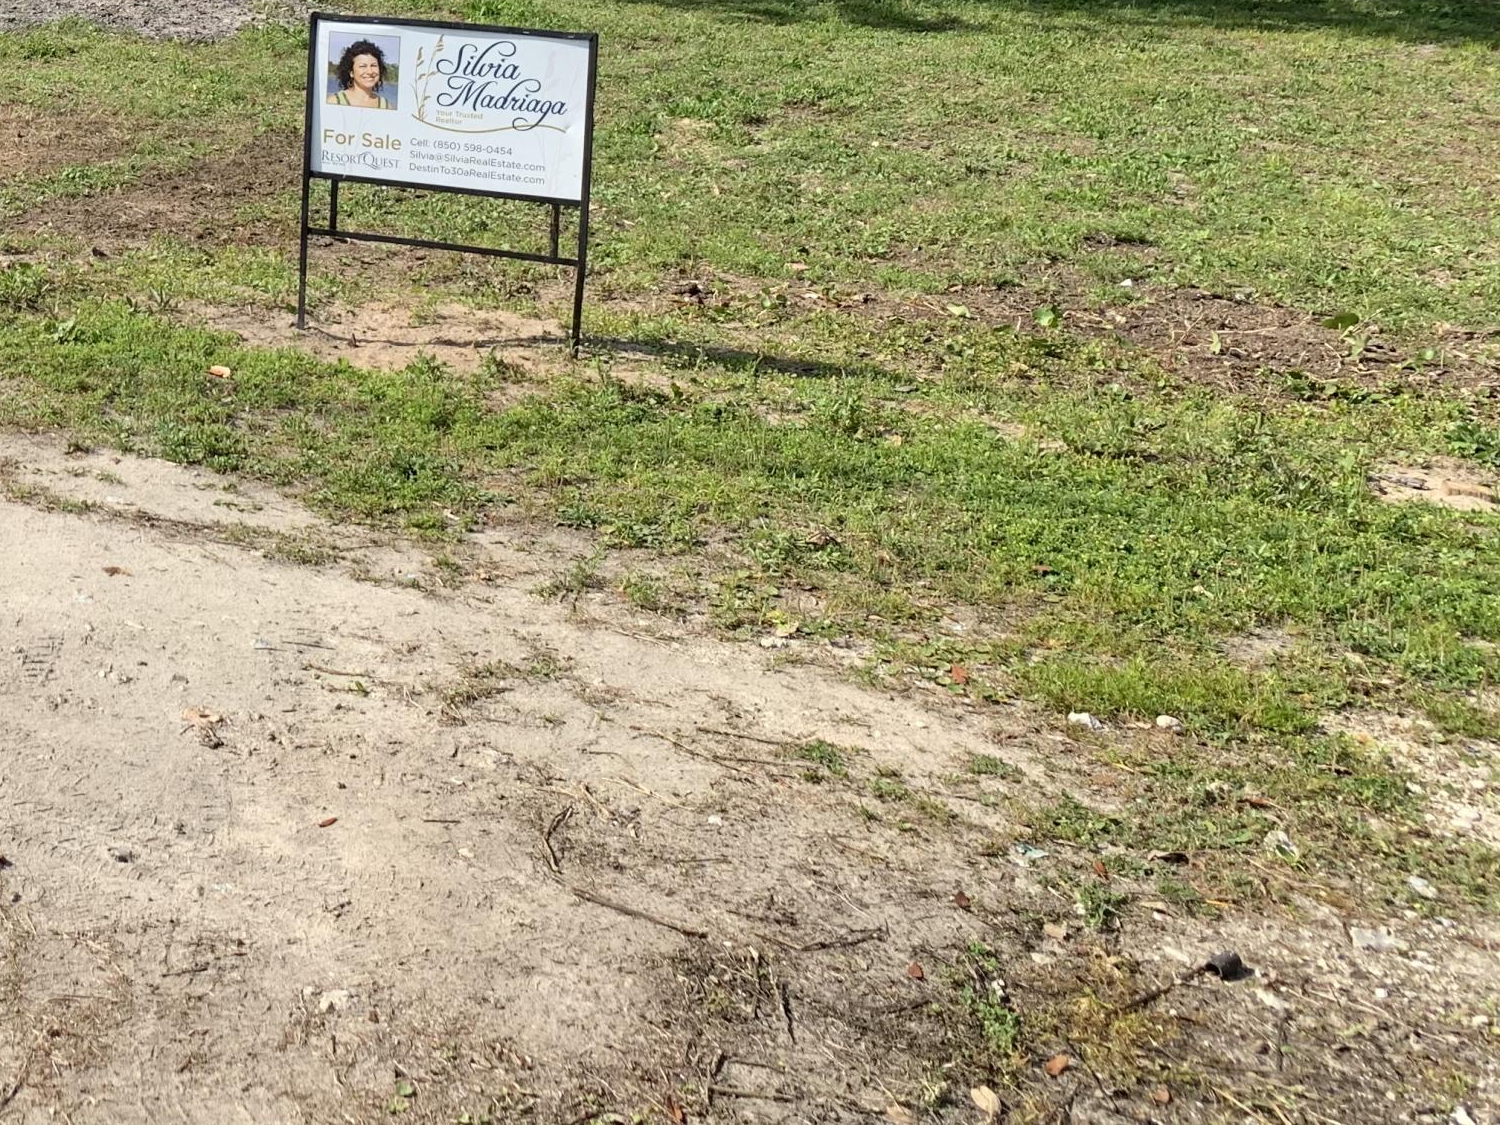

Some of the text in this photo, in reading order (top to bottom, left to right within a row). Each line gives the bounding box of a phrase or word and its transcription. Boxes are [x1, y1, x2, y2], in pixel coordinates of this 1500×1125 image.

[436, 40, 521, 81] Silvia
[436, 75, 569, 132] Madriaga
[323, 129, 402, 151] For Sale
[433, 139, 461, 151] (850)
[464, 142, 513, 156] 598-0454
[409, 150, 546, 172] Silvia@SilviaRealEstate.com
[409, 162, 546, 185] DestinTo30aRealEstate.com
